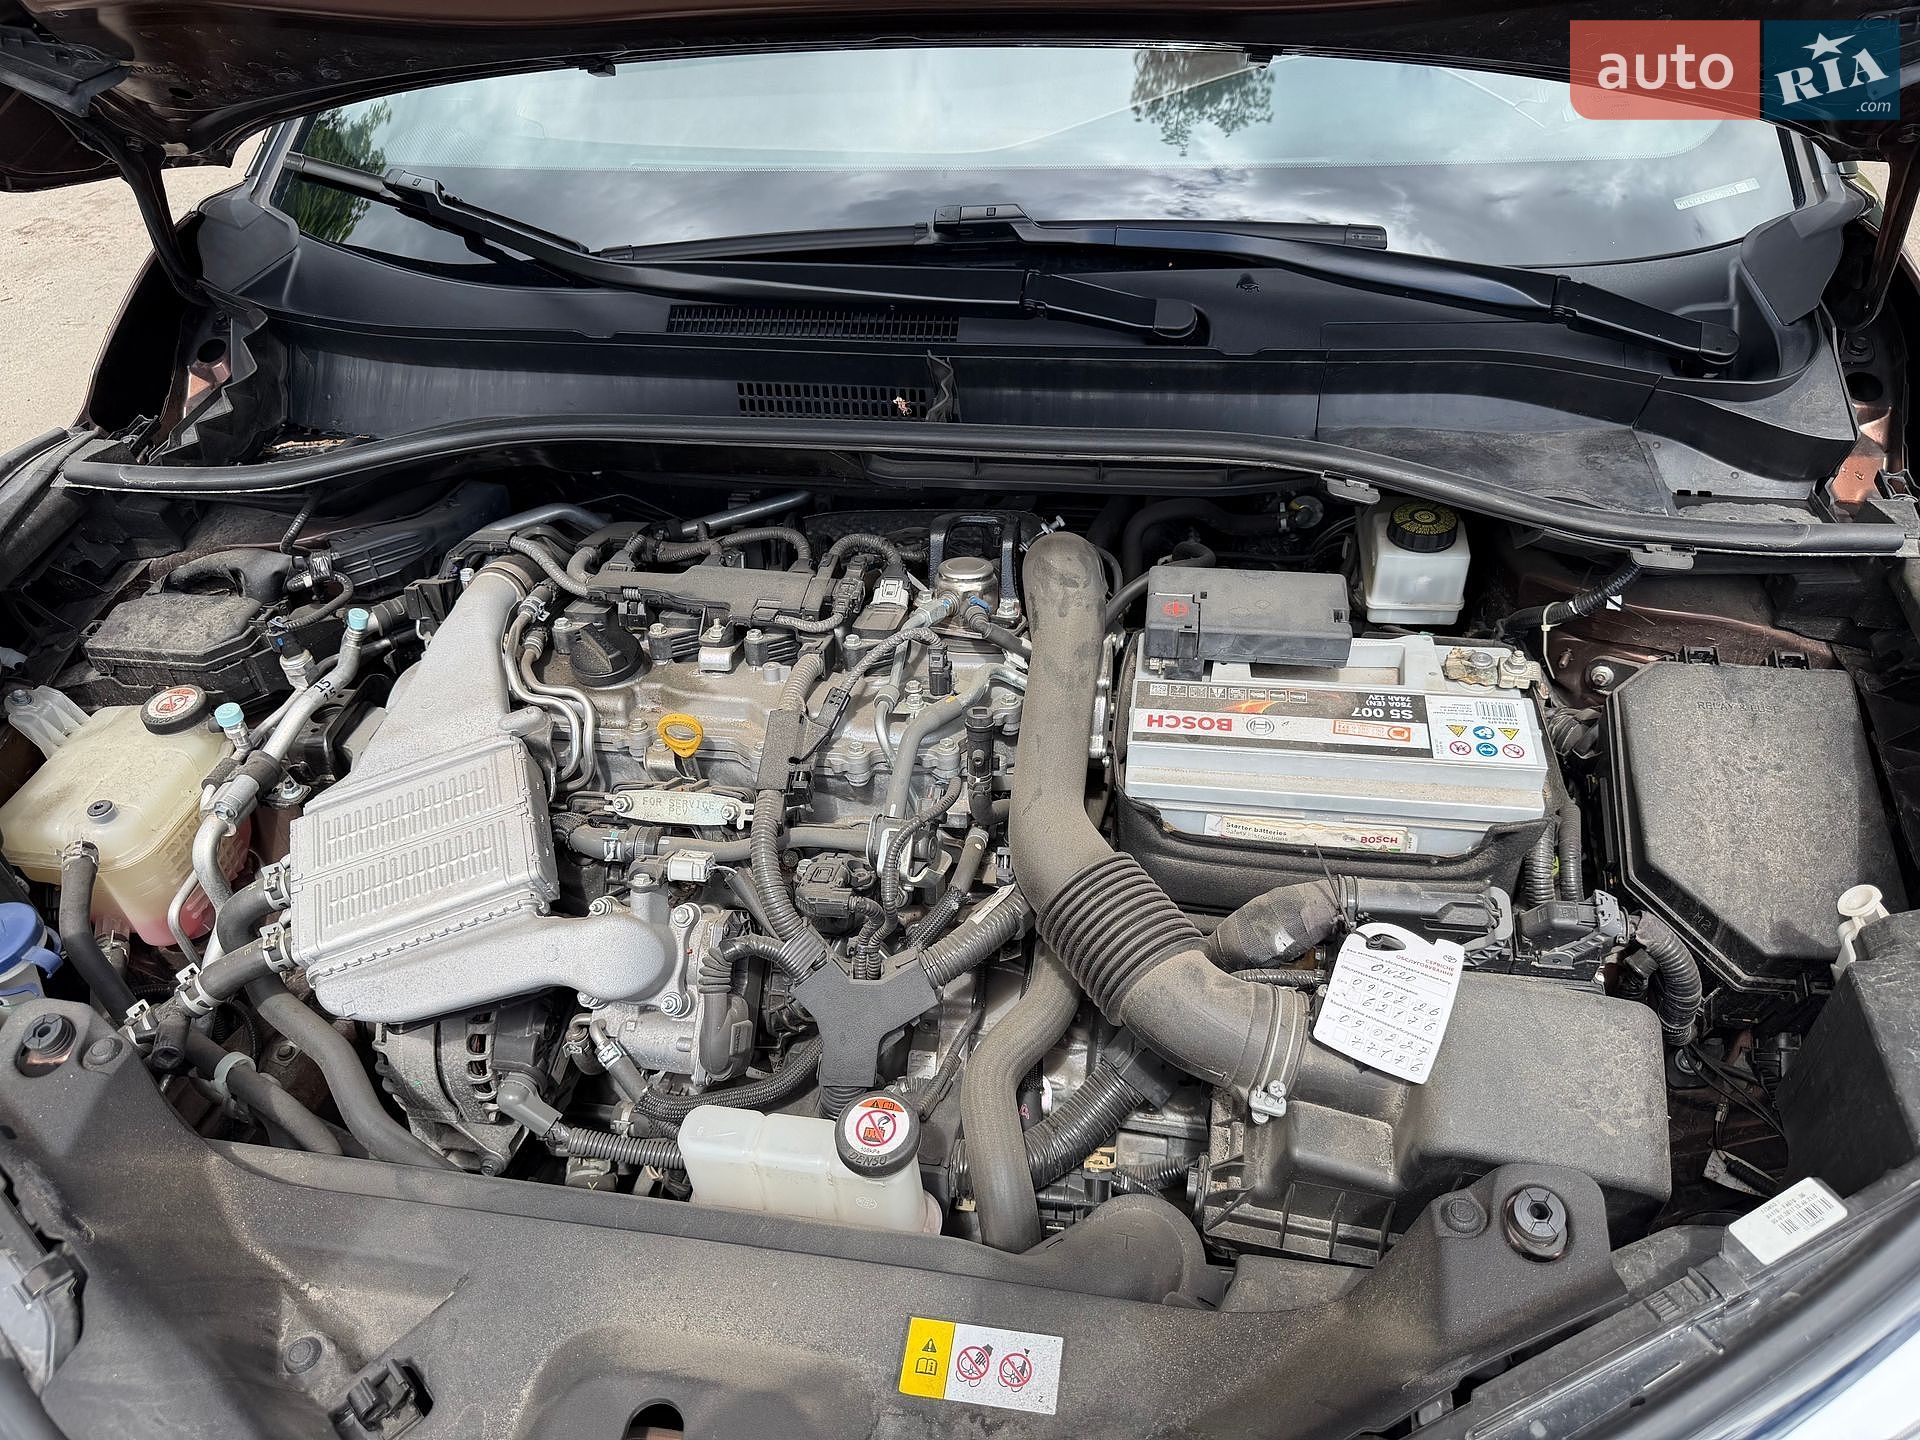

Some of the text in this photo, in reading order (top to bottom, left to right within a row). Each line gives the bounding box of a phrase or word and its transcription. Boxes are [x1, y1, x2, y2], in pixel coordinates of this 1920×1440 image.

[1351, 707, 1413, 720] S5 007
[1147, 714, 1233, 732] BOSCH
[642, 796, 716, 810] FOR SERVICE
[1226, 822, 1287, 836] Starter batteries
[1360, 836, 1398, 844] BOSCH
[847, 1150, 888, 1166] DENSO
